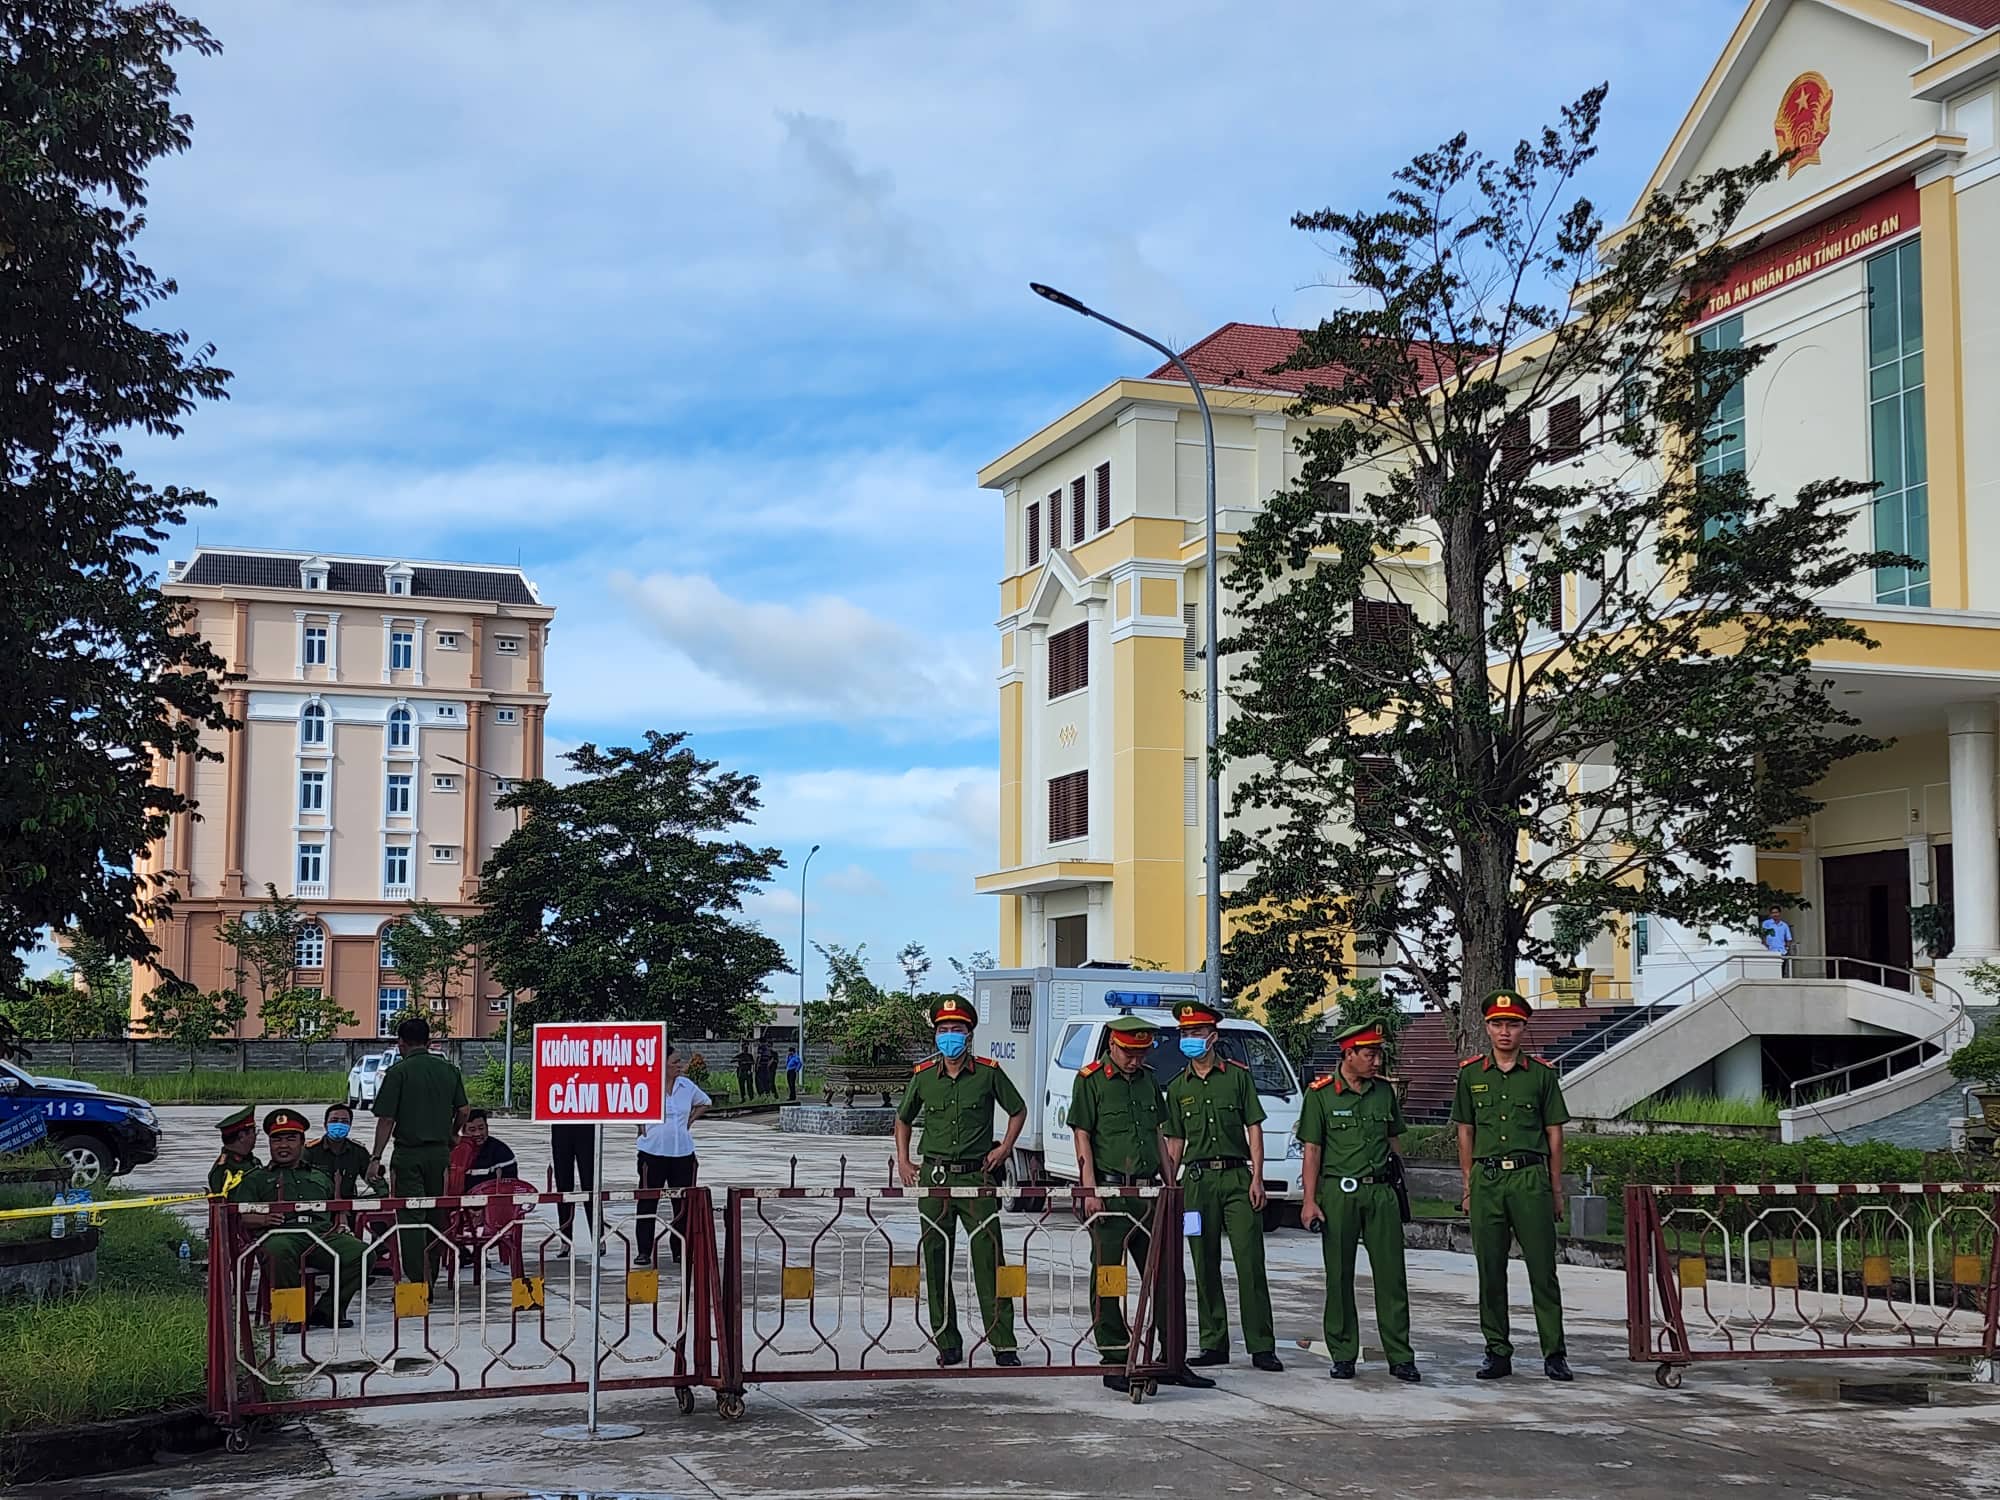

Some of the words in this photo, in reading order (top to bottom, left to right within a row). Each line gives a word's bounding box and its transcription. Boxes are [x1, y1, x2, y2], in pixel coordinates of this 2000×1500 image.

[1708, 291, 1731, 314] TÒA
[1733, 279, 1750, 302] ÁN
[1752, 266, 1784, 293] NHÂN
[1786, 255, 1812, 279] DÂN
[1844, 225, 1879, 252] LONG
[1881, 215, 1899, 237] AN
[541, 1034, 590, 1067] KHÔNG
[592, 1033, 632, 1072] PHẬN
[635, 1035, 657, 1072] SỰ
[990, 1040, 1016, 1060] POLICE
[548, 1073, 600, 1114] CẤM
[605, 1076, 649, 1114] VÀO
